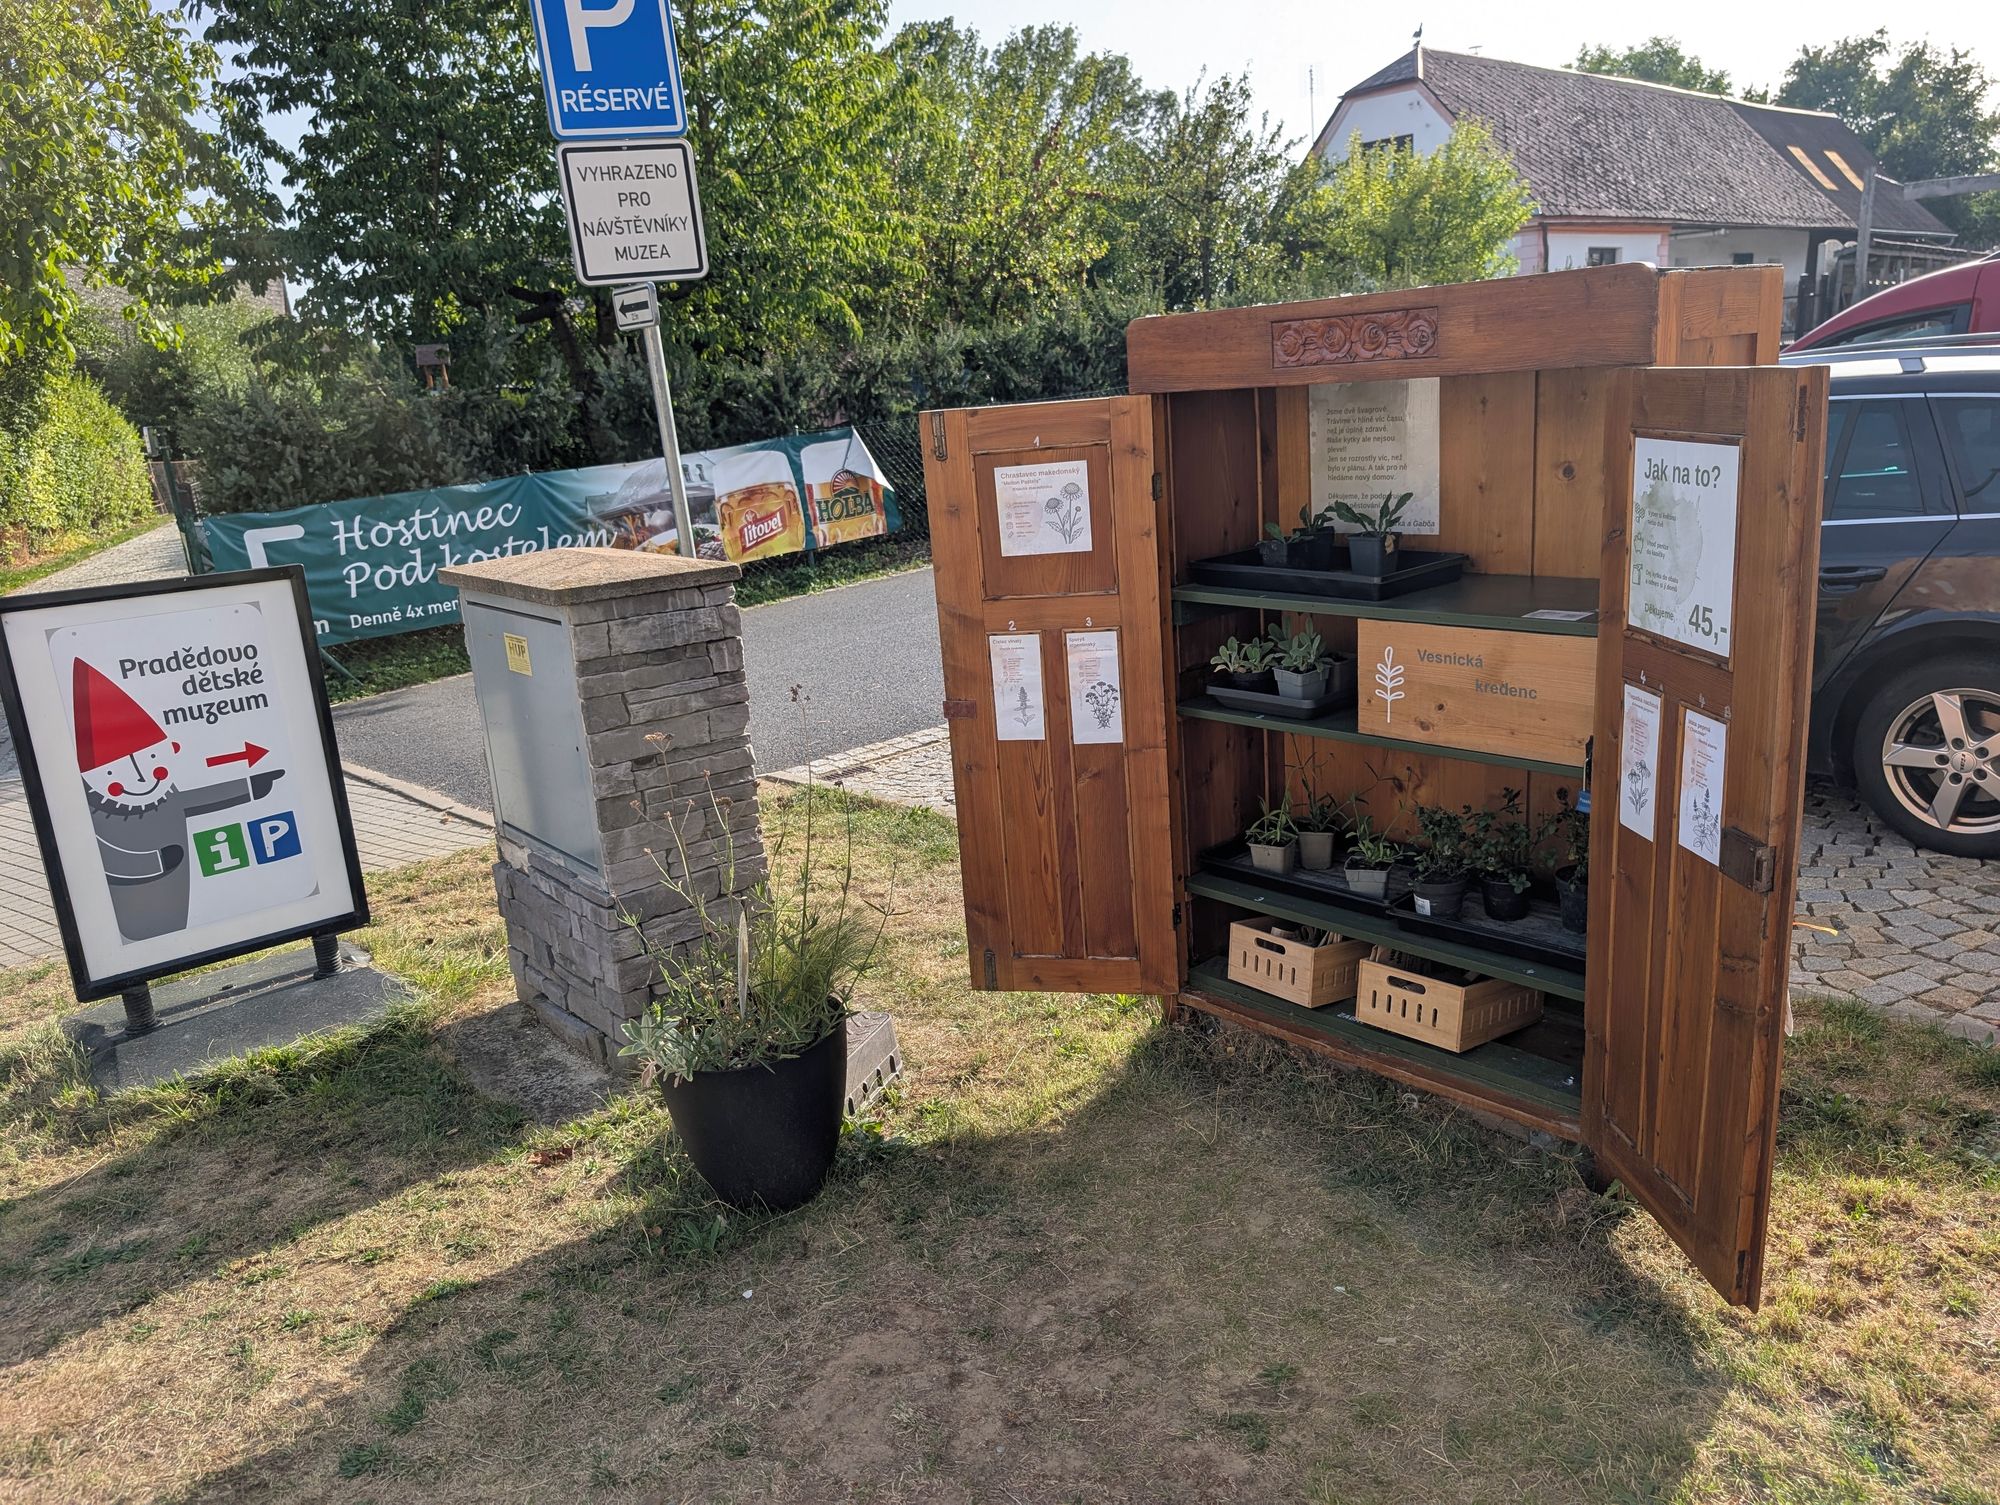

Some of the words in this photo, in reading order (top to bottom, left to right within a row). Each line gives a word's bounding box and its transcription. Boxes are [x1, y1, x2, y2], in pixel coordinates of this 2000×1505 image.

[564, 0, 636, 72] P
[561, 82, 670, 113] RÉSERVÉ
[577, 163, 677, 182] VYHRAZENO
[617, 192, 651, 207] PRO
[582, 214, 688, 237] NÁVŠTĚVNÍKY
[614, 244, 671, 262] MUZEA
[1001, 471, 1037, 479] Chrastavec
[1038, 467, 1080, 477] makedonský
[1328, 465, 1340, 473] bylo
[1644, 458, 1668, 482] Jak
[1672, 465, 1690, 485] na
[1695, 464, 1721, 488] to?
[816, 492, 875, 524] HOLBA
[330, 503, 521, 556] Hostinec
[744, 512, 783, 548] Litovel
[342, 548, 436, 598] Pod
[350, 606, 402, 629] Denně
[405, 604, 424, 619] 4x
[1008, 620, 1017, 631] 2
[1085, 617, 1092, 627] 3
[1688, 604, 1728, 645] 45,-
[119, 644, 258, 679] Pradědovo
[1417, 648, 1484, 668] Vesnická
[182, 662, 264, 696] dětské
[1475, 679, 1537, 700] kredenc
[163, 693, 269, 725] muzeum
[261, 819, 290, 858] P
